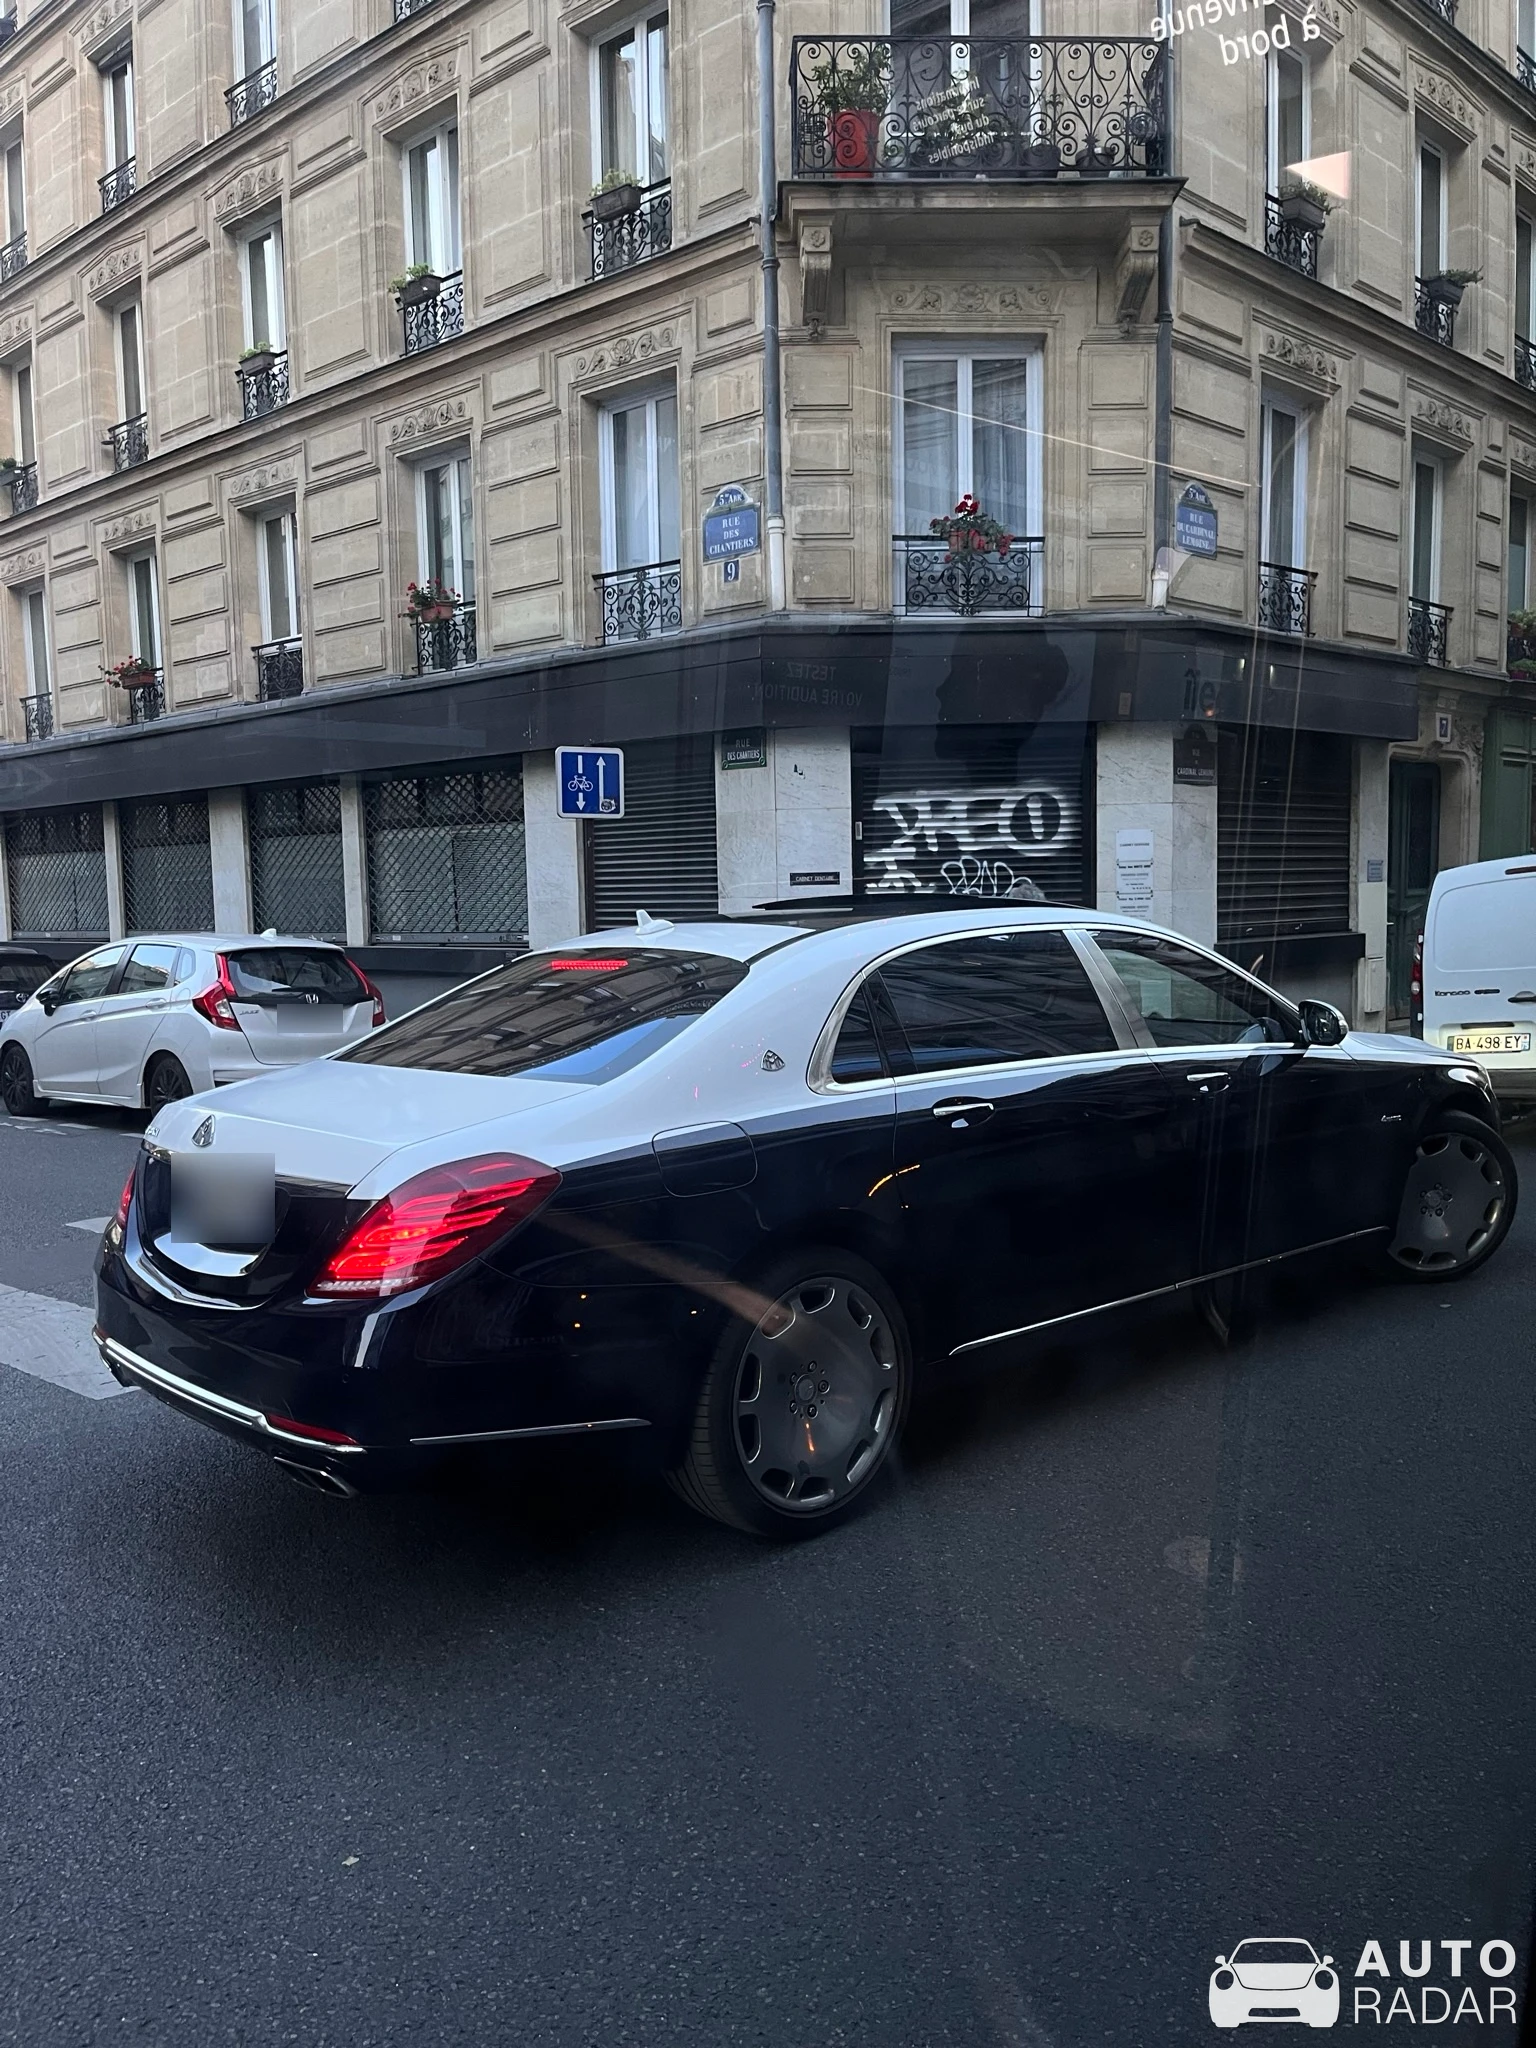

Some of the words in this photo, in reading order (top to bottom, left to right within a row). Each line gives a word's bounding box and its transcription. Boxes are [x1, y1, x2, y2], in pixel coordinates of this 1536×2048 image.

[722, 516, 740, 528] RUE
[1189, 513, 1204, 525] RUE
[723, 529, 740, 540] DES
[1185, 524, 1215, 540] CARDINAL
[709, 537, 755, 555] CHANTIERS
[1182, 534, 1211, 550] LEMOINE
[727, 562, 736, 581] 9
[735, 738, 750, 748] RUE
[727, 752, 736, 761] DES
[736, 749, 760, 760] CHANTIERS
